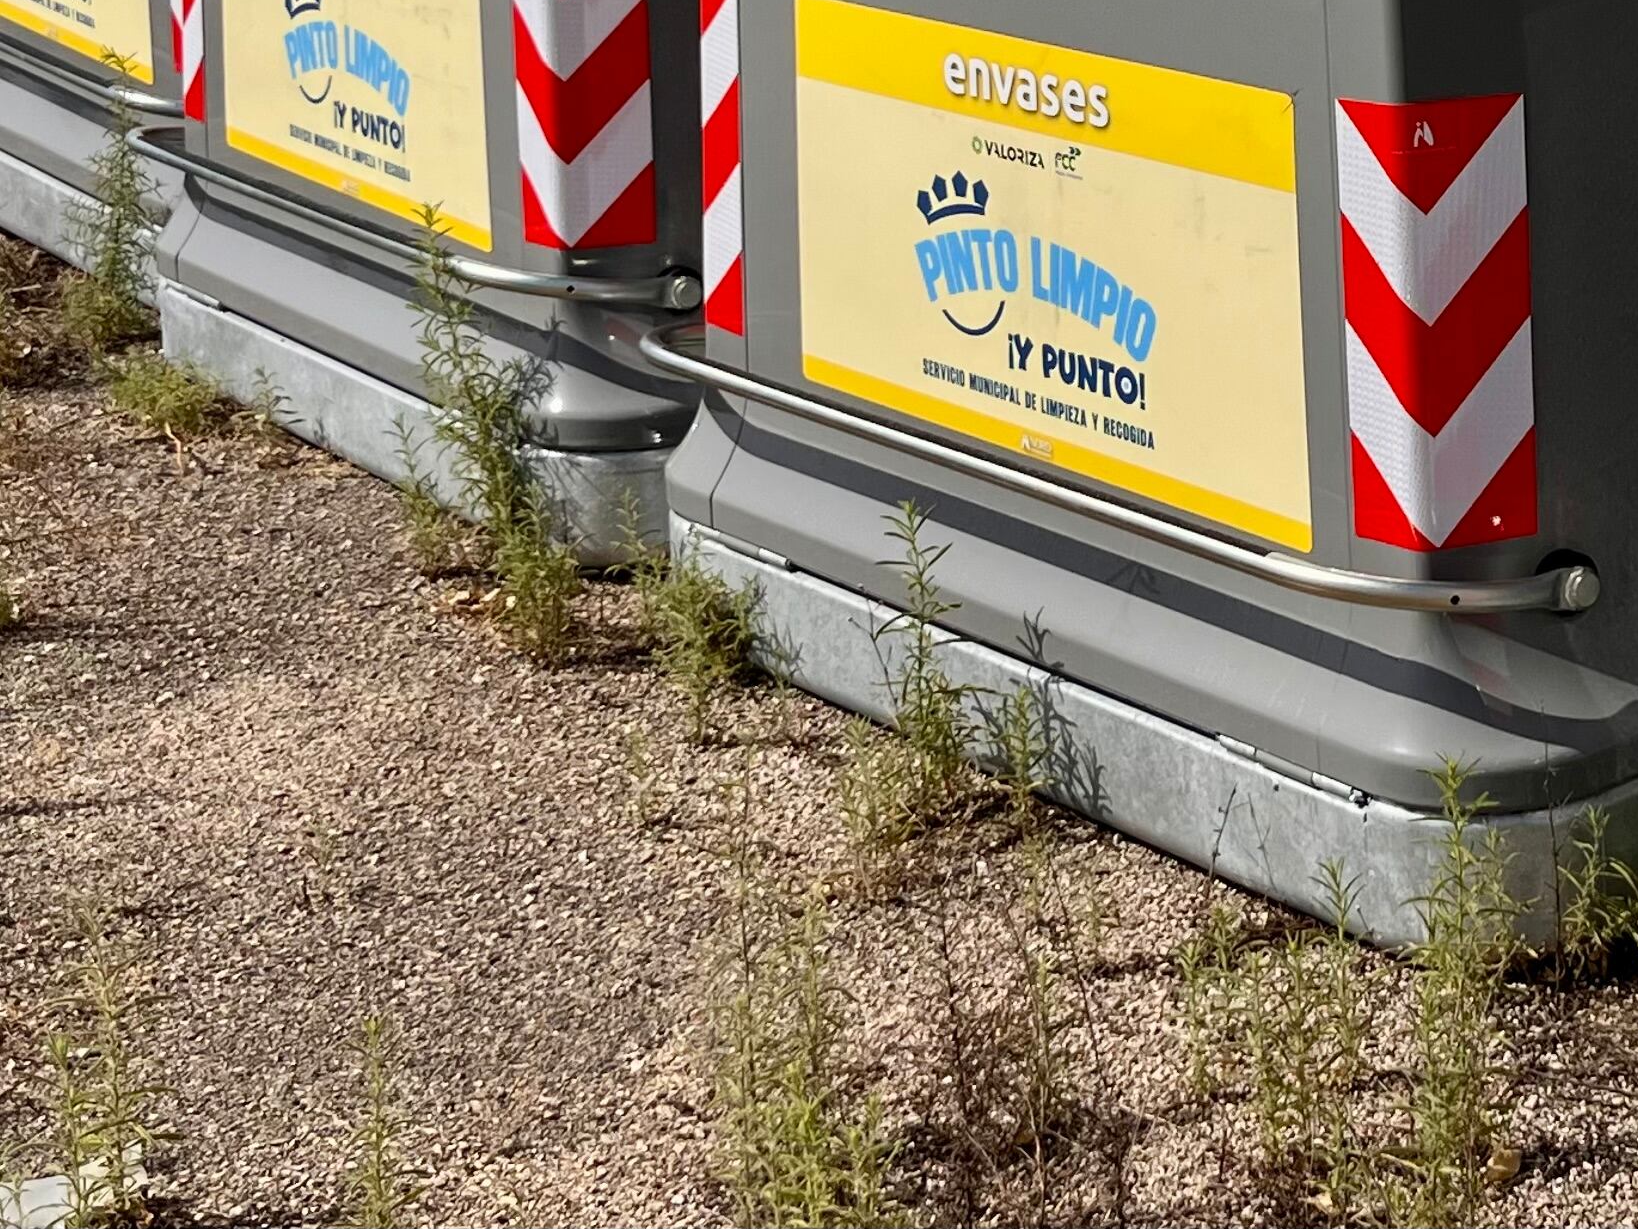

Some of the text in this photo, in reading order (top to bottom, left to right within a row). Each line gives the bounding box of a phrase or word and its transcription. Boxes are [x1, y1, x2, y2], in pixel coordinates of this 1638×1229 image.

[284, 20, 338, 79] PINTO
[944, 53, 1110, 128] envases
[351, 106, 406, 153] PUNTO!
[984, 139, 1045, 169] VALORIZA
[914, 229, 1157, 362] PINTO LIMPIO
[922, 358, 1156, 450] SERVICIO MUNICIPAL DE LIMPIEZA Y RECOGIDA
[1042, 343, 1146, 410] PUNTO!
